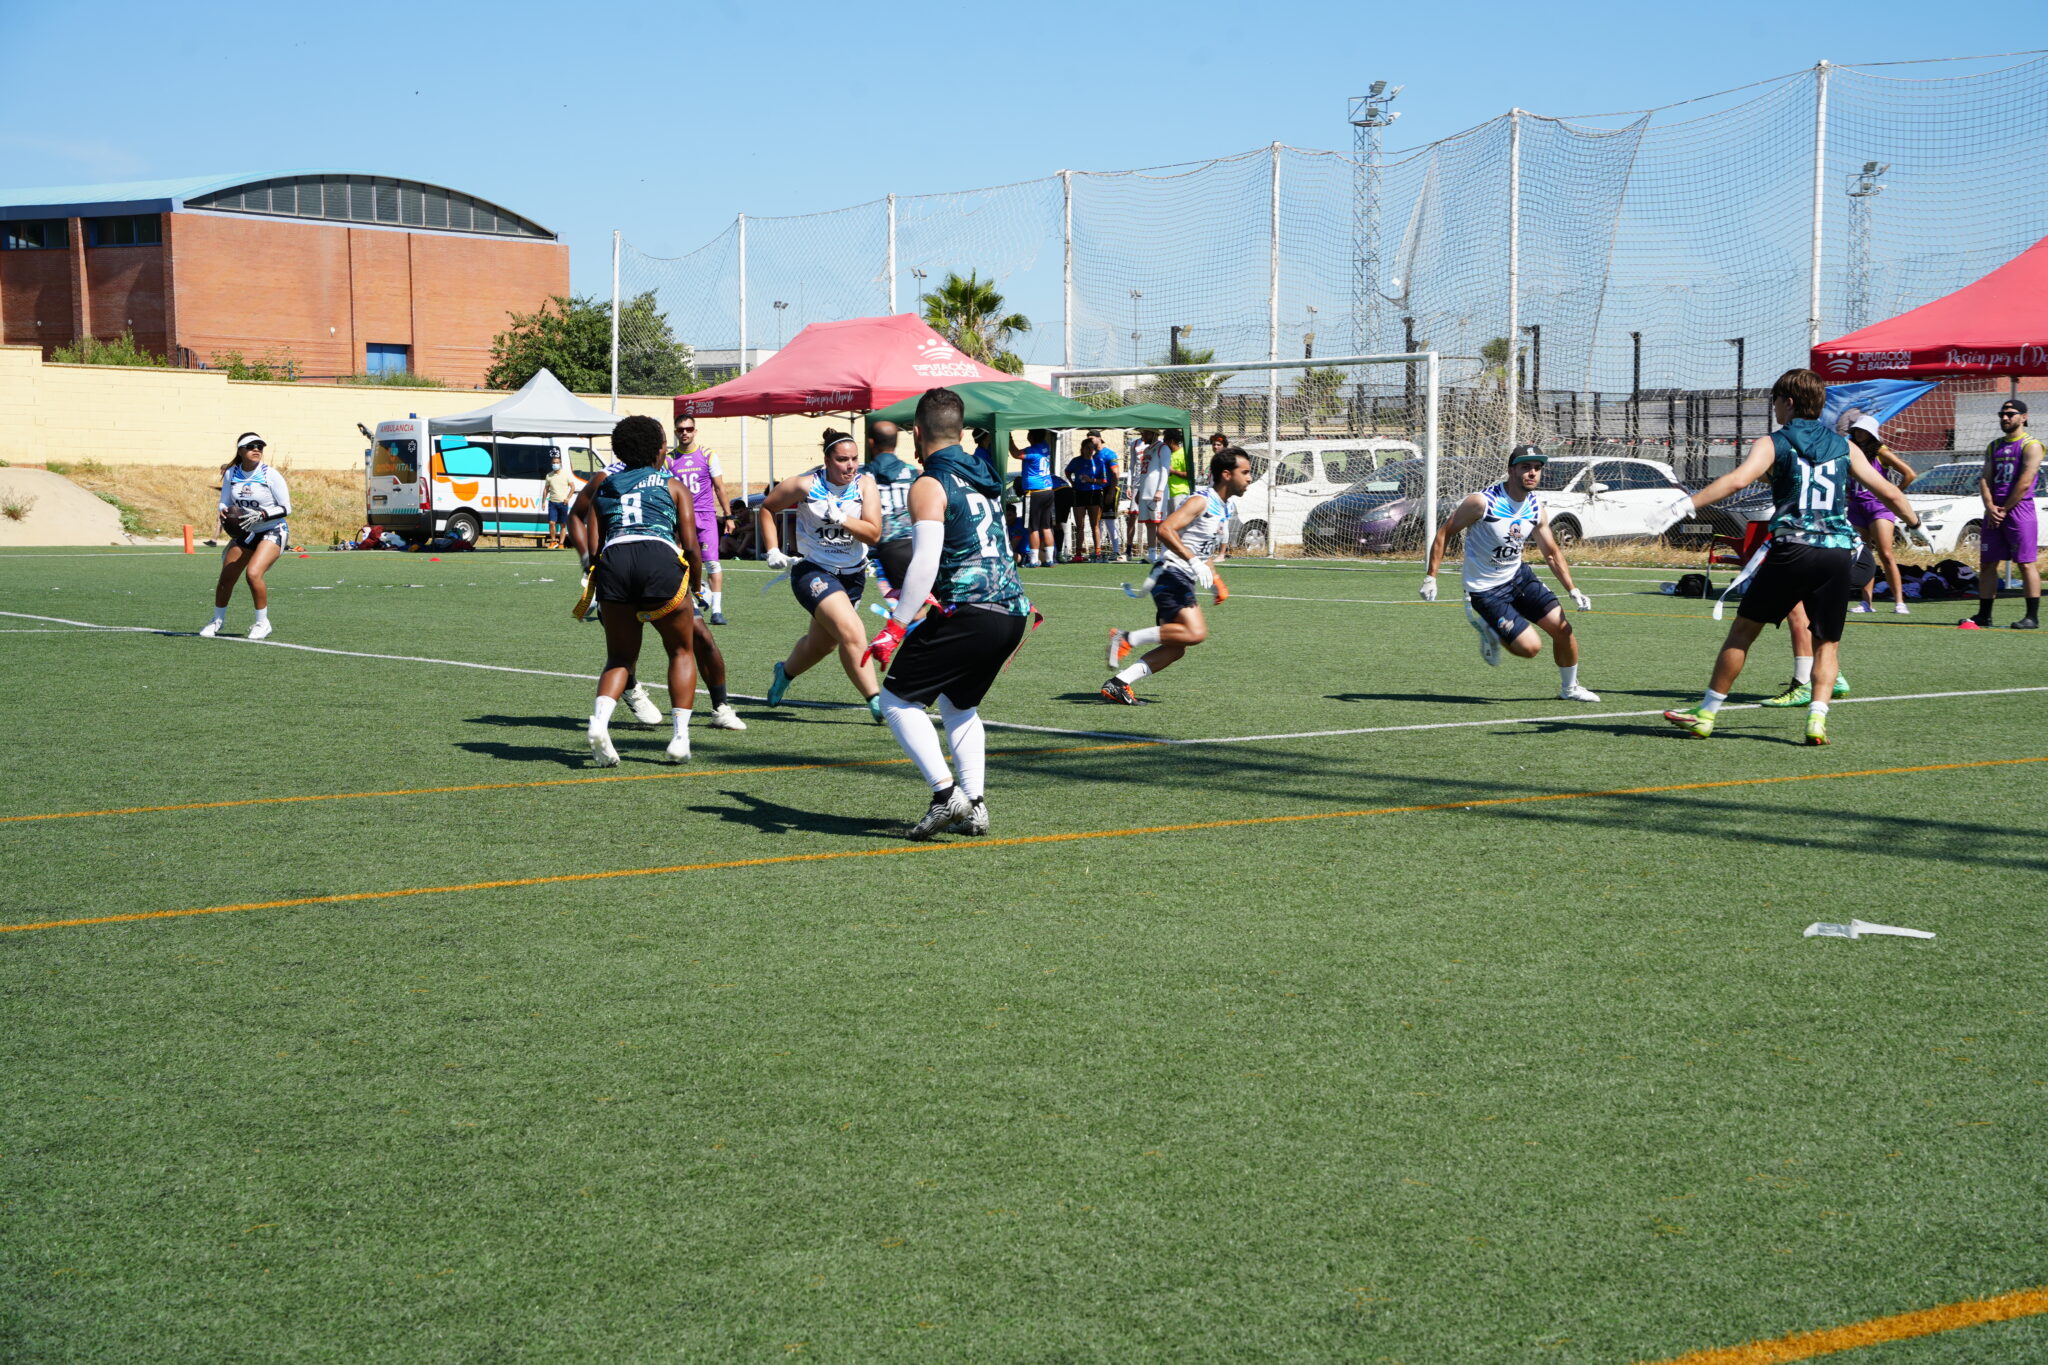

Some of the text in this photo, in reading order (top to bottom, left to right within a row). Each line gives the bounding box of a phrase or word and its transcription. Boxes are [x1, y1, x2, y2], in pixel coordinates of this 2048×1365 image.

[1858, 349, 1912, 361] DIPUTACIÓN
[1987, 353, 2011, 370] por
[1867, 360, 1911, 370] BADAJOZ
[380, 423, 414, 432] AMBULANCIA
[1994, 462, 2015, 484] 28
[681, 472, 701, 494] 16
[1796, 457, 1836, 511] 15
[481, 493, 540, 509] ambuV
[620, 492, 643, 526] 8
